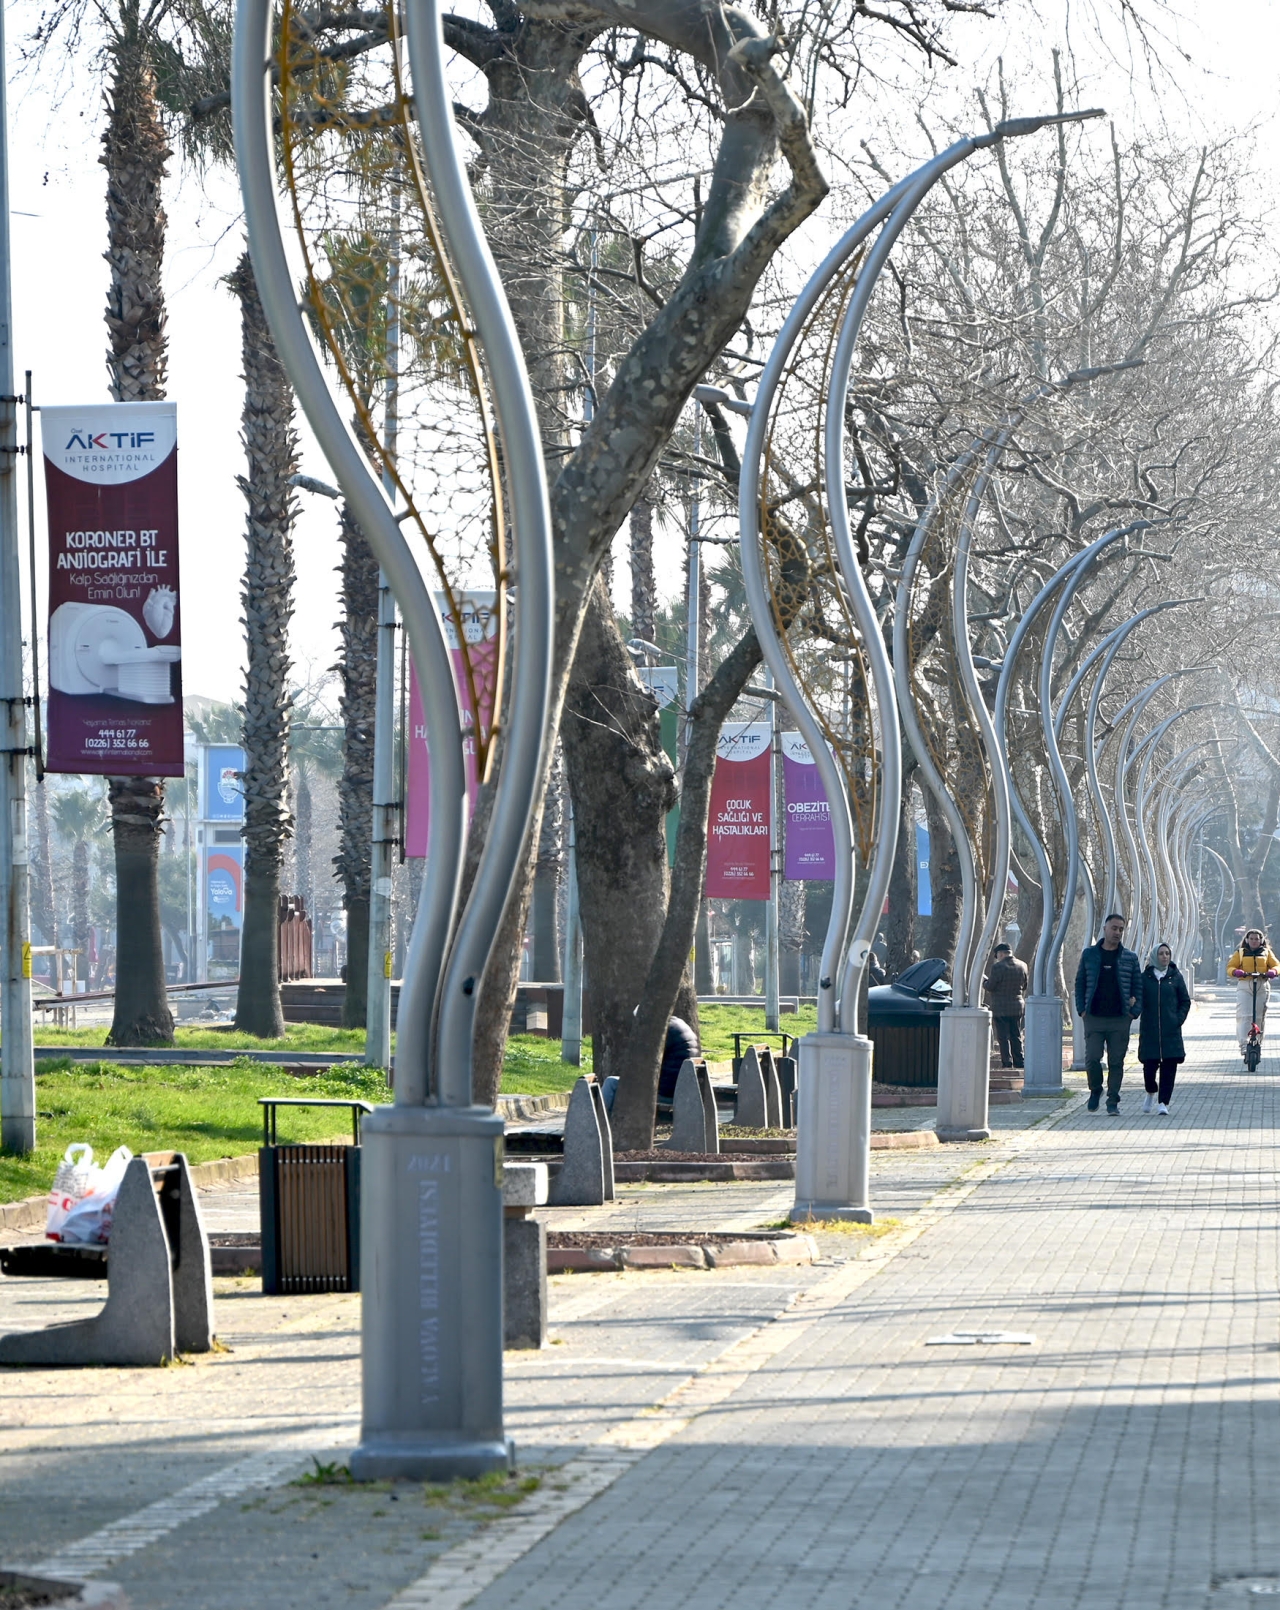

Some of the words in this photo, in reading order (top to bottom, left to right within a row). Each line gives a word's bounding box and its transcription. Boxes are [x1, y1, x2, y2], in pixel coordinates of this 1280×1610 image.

[65, 454, 155, 463] INTERNATIONAL
[82, 464, 139, 472] HOSPITAL
[65, 530, 136, 549] KORONER
[140, 530, 158, 547] BT
[56, 547, 141, 569] ANJİOGRAFİ
[145, 547, 167, 567] İLE
[69, 572, 92, 587] Kalp
[88, 587, 113, 599] Emin
[98, 729, 115, 738] 444
[116, 729, 125, 738] 61
[126, 729, 136, 738] 77
[85, 738, 110, 748] (0226)
[112, 739, 126, 748] 352
[127, 739, 137, 748] 66
[138, 739, 149, 748] 66
[726, 799, 752, 812] ÇOCUK
[717, 811, 750, 823] SAĞLIĞI
[752, 812, 763, 823] VE
[712, 825, 768, 835] HASTALIKLARI
